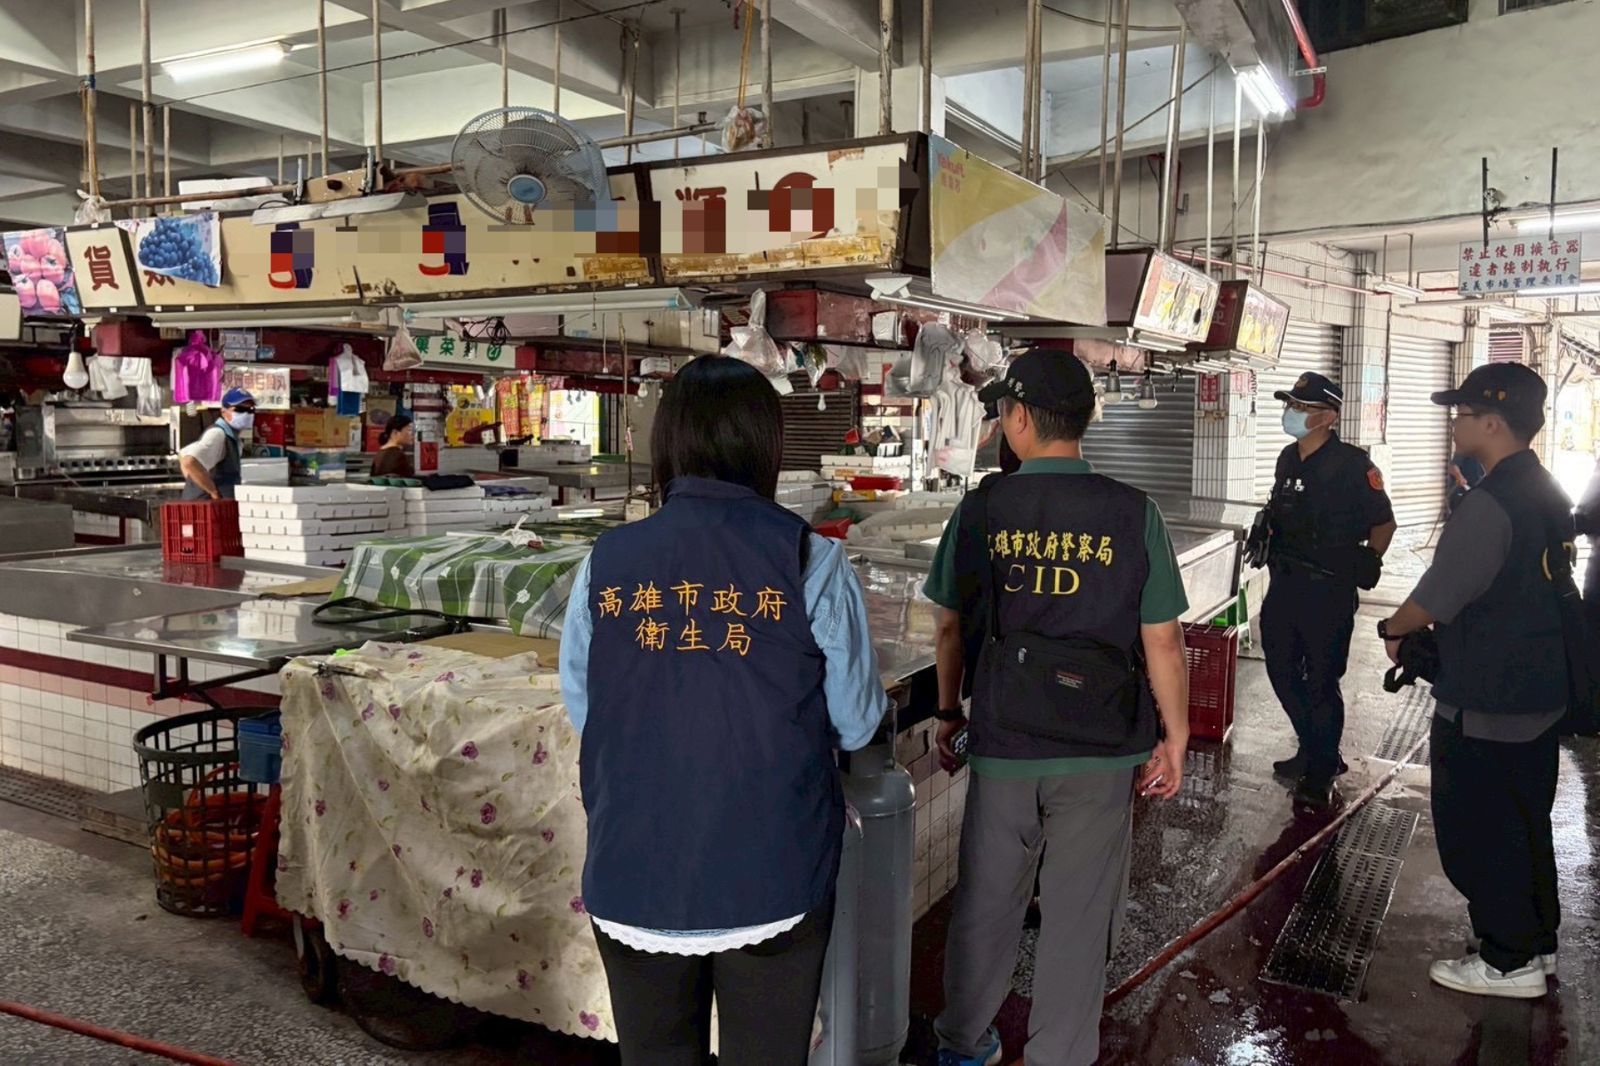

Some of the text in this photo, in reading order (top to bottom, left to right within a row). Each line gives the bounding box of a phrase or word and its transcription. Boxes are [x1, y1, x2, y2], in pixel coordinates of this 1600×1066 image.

[84, 246, 119, 291] 貨
[987, 529, 1113, 566] 雄市政府警察局
[1004, 563, 1080, 595] CID
[598, 580, 787, 621] 高雄市政府
[635, 617, 752, 657] 衛生局
